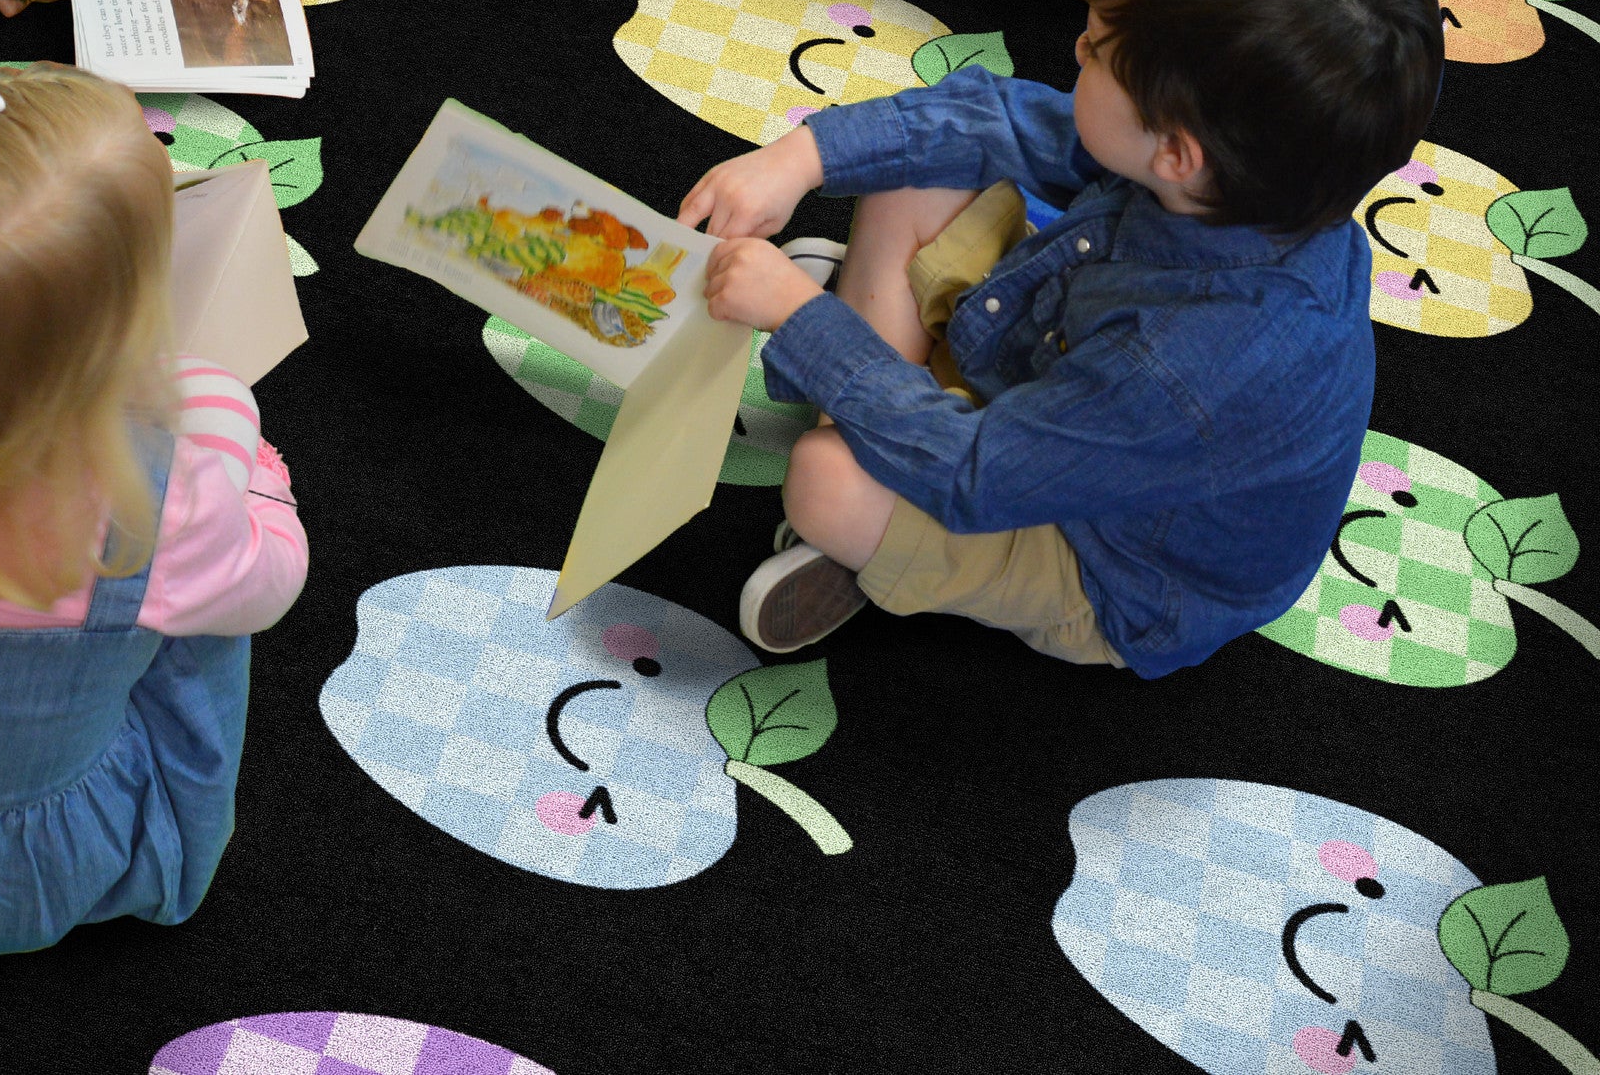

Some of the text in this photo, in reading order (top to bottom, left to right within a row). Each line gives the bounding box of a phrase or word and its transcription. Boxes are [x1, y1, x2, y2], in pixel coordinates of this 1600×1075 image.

[139, 1, 148, 12] for
[153, 0, 162, 13] and
[113, 8, 123, 25] long
[144, 15, 153, 33] hour
[103, 24, 111, 40] they
[131, 20, 143, 56] breathing
[148, 36, 155, 44] an
[157, 16, 171, 55] crocodiles
[106, 43, 114, 57] But
[119, 35, 128, 57] water
